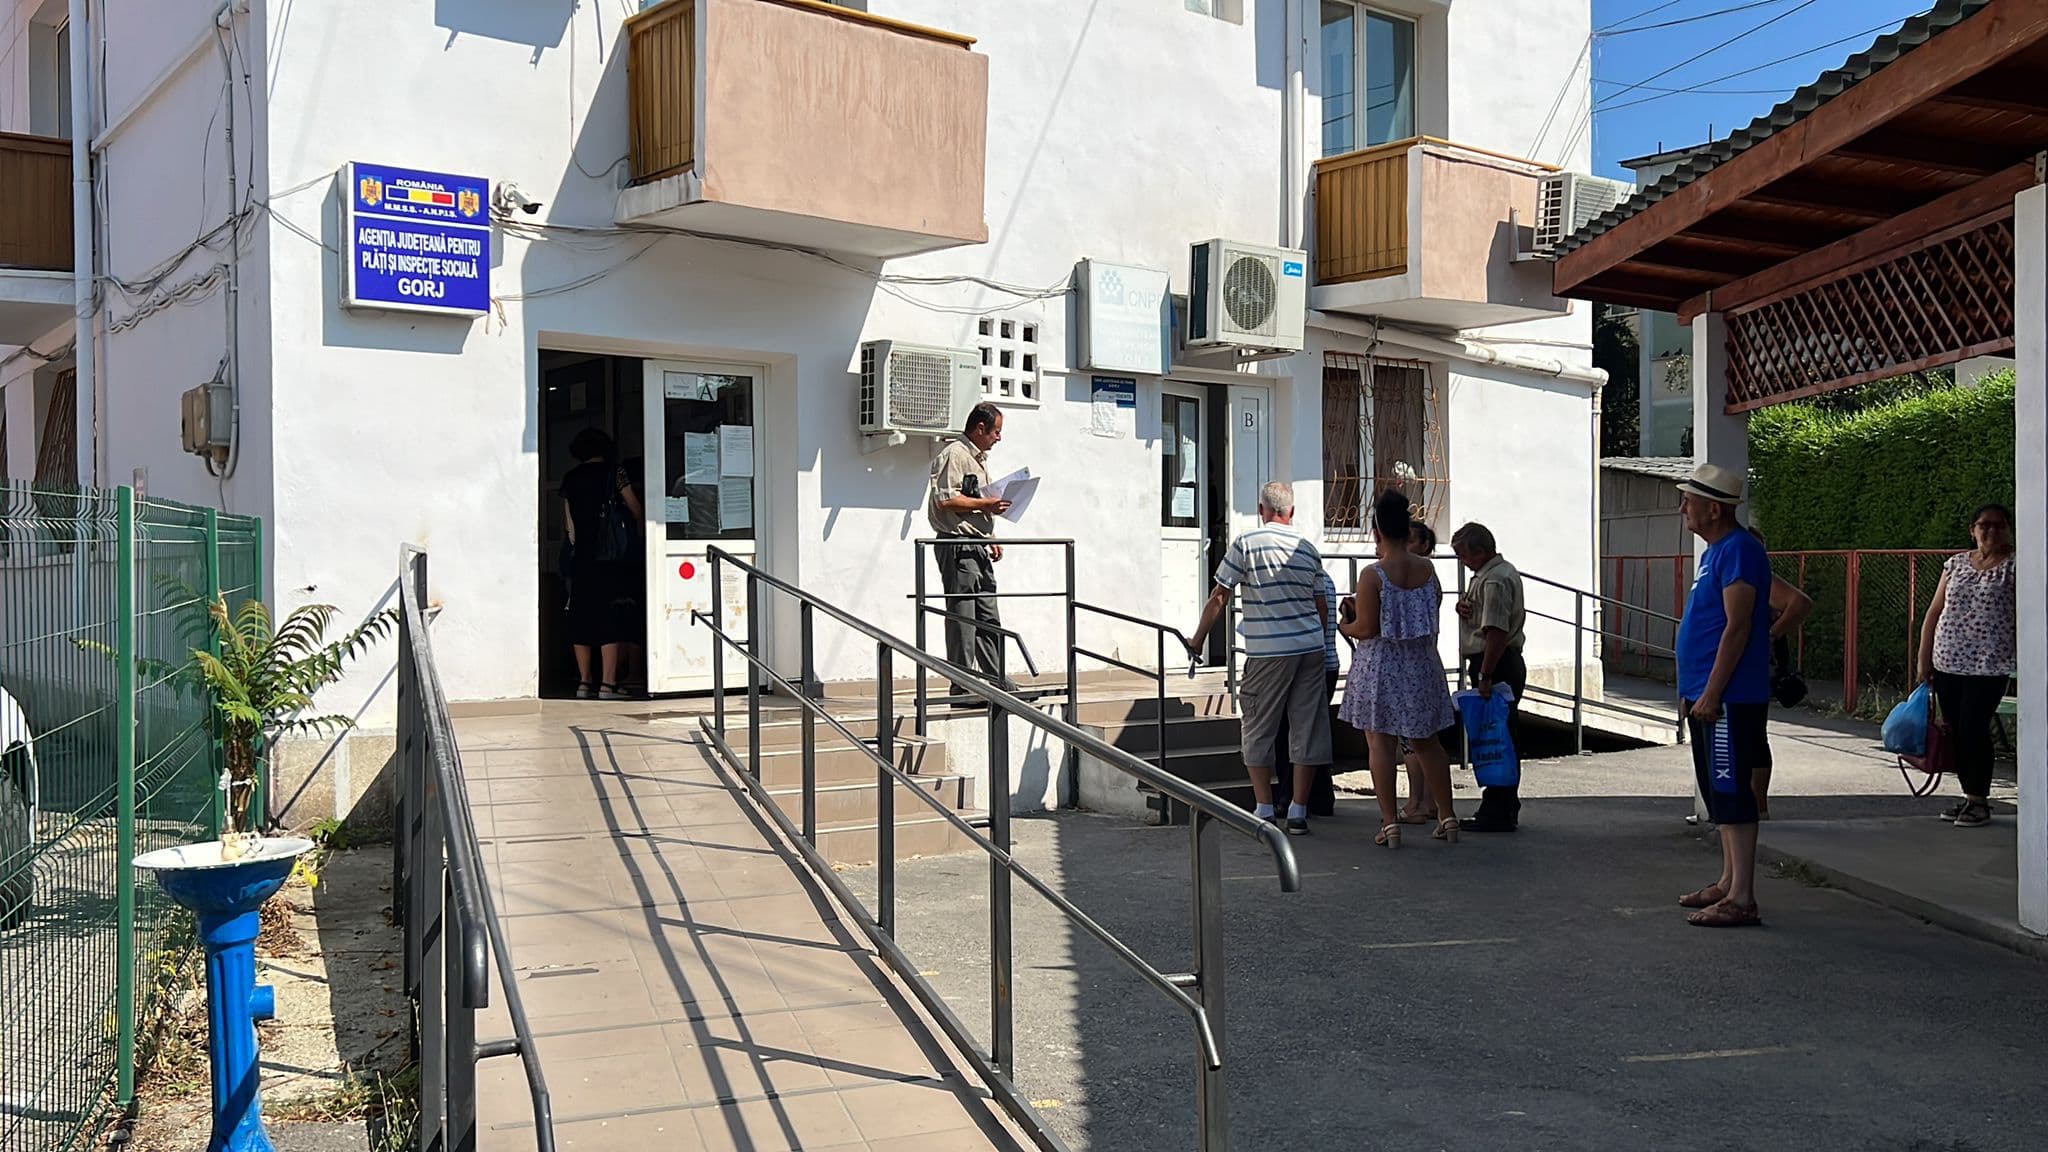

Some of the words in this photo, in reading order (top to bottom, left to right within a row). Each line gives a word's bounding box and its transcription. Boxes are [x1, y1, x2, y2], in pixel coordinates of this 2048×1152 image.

[396, 179, 445, 192] ROMÂNIA
[448, 237, 481, 257] PENTRU
[442, 259, 479, 279] SOCIALĂ
[398, 278, 445, 298] GORJ
[699, 382, 714, 400] A
[1244, 412, 1254, 427] B
